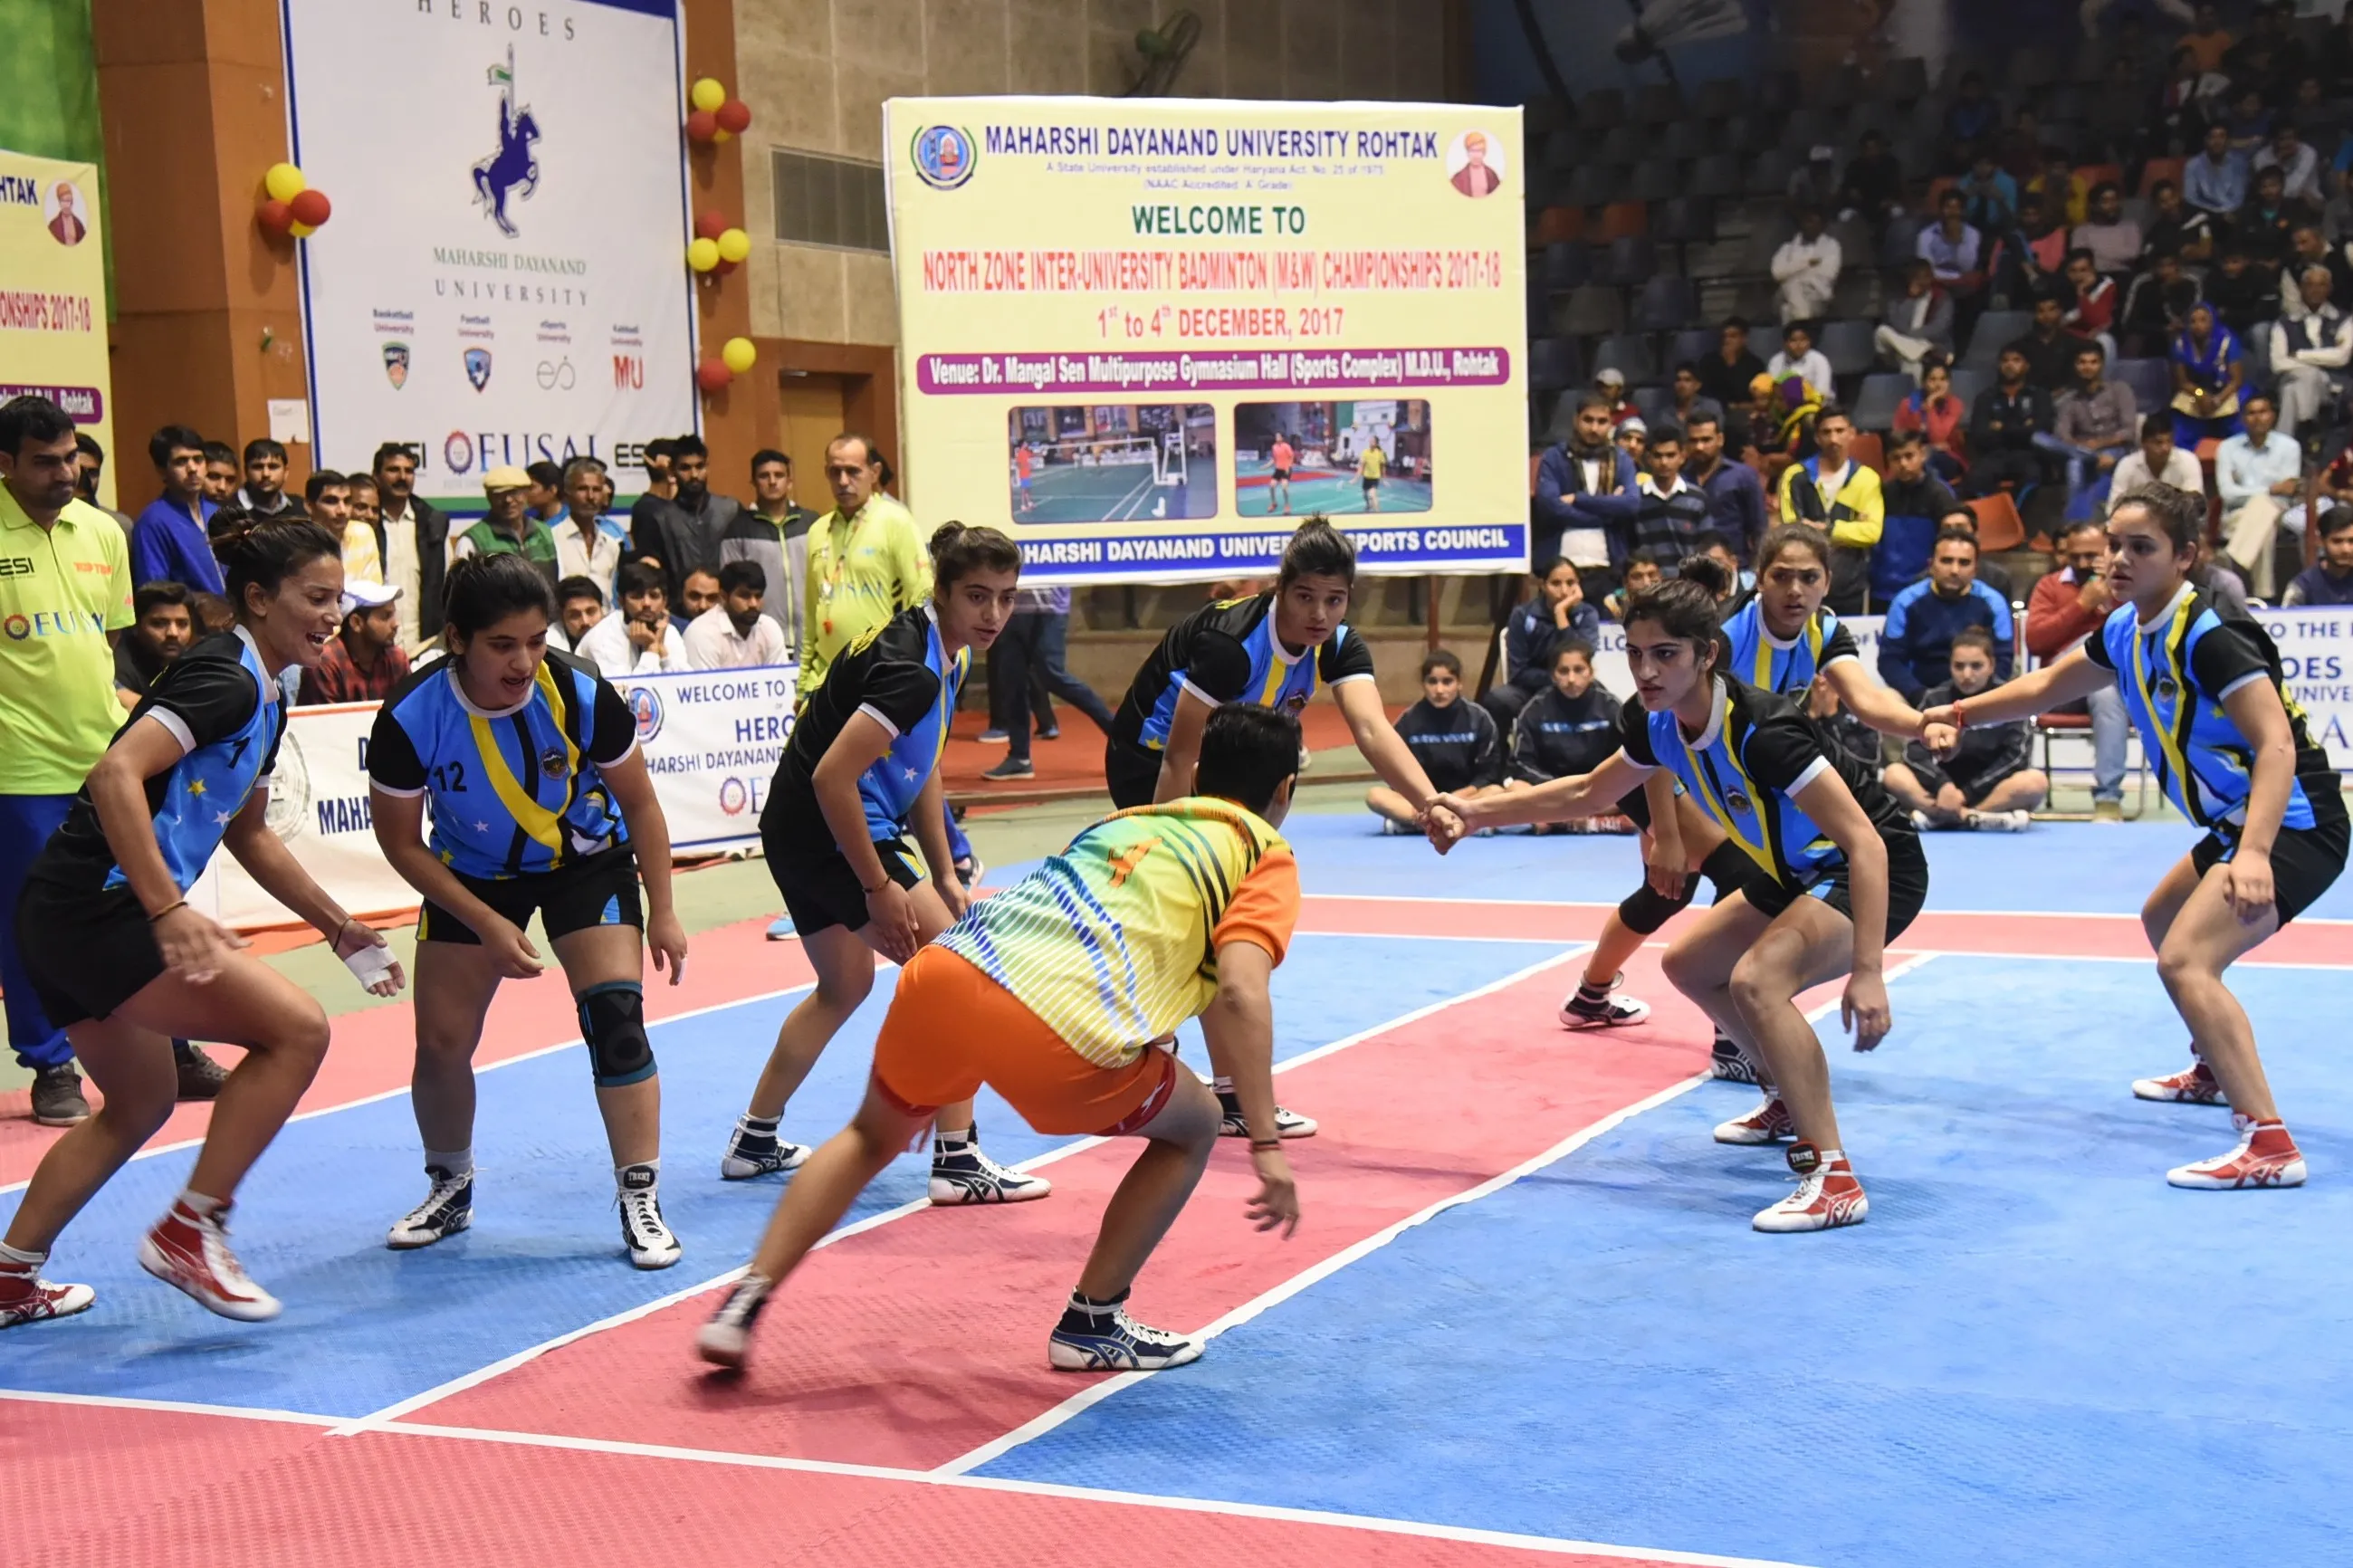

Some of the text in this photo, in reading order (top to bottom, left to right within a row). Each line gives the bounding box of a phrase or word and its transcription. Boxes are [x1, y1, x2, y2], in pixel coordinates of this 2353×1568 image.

[417, 0, 575, 41] HEROES
[986, 125, 1438, 158] MAHARSHI DAYANAND UNIVERSITY ROHTAK
[1057, 163, 1084, 173] State
[1088, 163, 1141, 175] University
[1146, 163, 1206, 173] established
[1243, 164, 1285, 176] Haryana
[0, 176, 39, 206] HTAK
[1132, 206, 1306, 234] WELCOME TO
[434, 247, 587, 275] MAHARSHI DAYANAND
[923, 251, 1501, 299] NORTH ZONE INTER-UNIVERSITY BADMINTON (M&W) CHAMPIONSHIPS 2017-18
[435, 279, 588, 306] UNIVERSITY
[0, 292, 91, 333] ONSHIPS 2017-18
[1125, 311, 1143, 337] to
[1179, 308, 1292, 341] DECEMBER,
[1300, 308, 1344, 336] 2017
[374, 323, 415, 336] University
[613, 355, 644, 390] MU
[929, 357, 980, 385] Venue:
[981, 356, 1002, 384] Dr.
[1005, 355, 1056, 390] Mangal
[1058, 355, 1086, 383] Sen
[1088, 354, 1178, 387] Multipurpose
[1180, 353, 1258, 387] Gymnasium
[1260, 352, 1288, 379] Hall
[1291, 351, 1338, 385] (Sports
[1341, 351, 1403, 384] Complex)
[1452, 349, 1499, 377] Rohtak
[1023, 541, 1101, 564] HARSHI
[1106, 538, 1214, 562] DAYANAND
[1424, 528, 1509, 550] COUNCIL
[2297, 621, 2339, 637] THE
[2281, 656, 2342, 680] OES
[676, 683, 760, 703] WELCOME
[765, 680, 785, 696] TO
[735, 714, 796, 743] HERO
[433, 760, 467, 793] 12
[646, 753, 701, 775] HARSHI
[317, 795, 372, 835] MAHA
